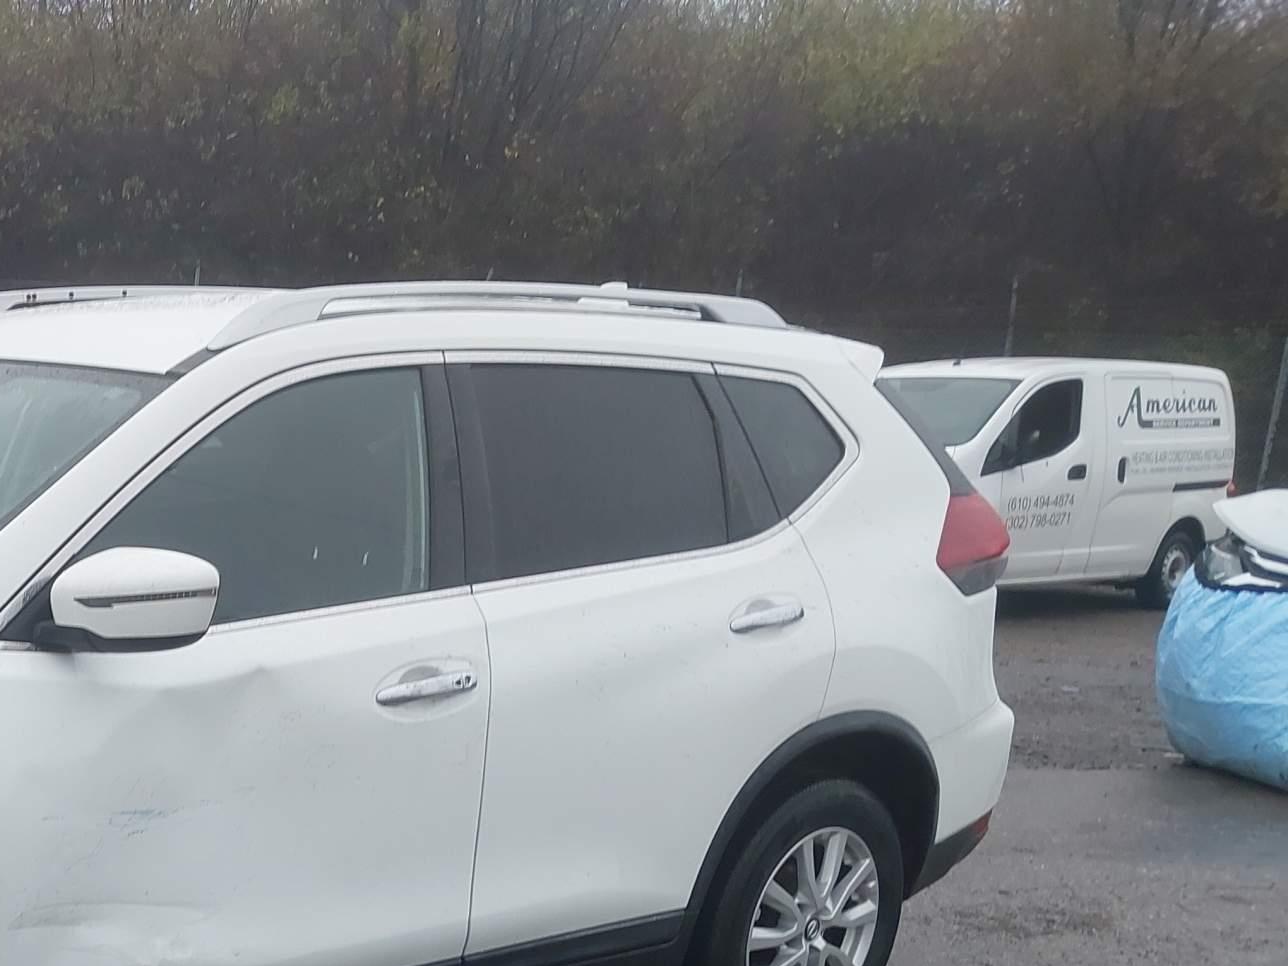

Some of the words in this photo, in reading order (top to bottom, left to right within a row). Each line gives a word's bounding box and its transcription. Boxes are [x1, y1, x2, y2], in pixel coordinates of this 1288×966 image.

[1117, 386, 1217, 428] American
[1008, 496, 1031, 512] (610)
[1033, 493, 1075, 509] 494-4874
[1030, 511, 1071, 528] 798-0271
